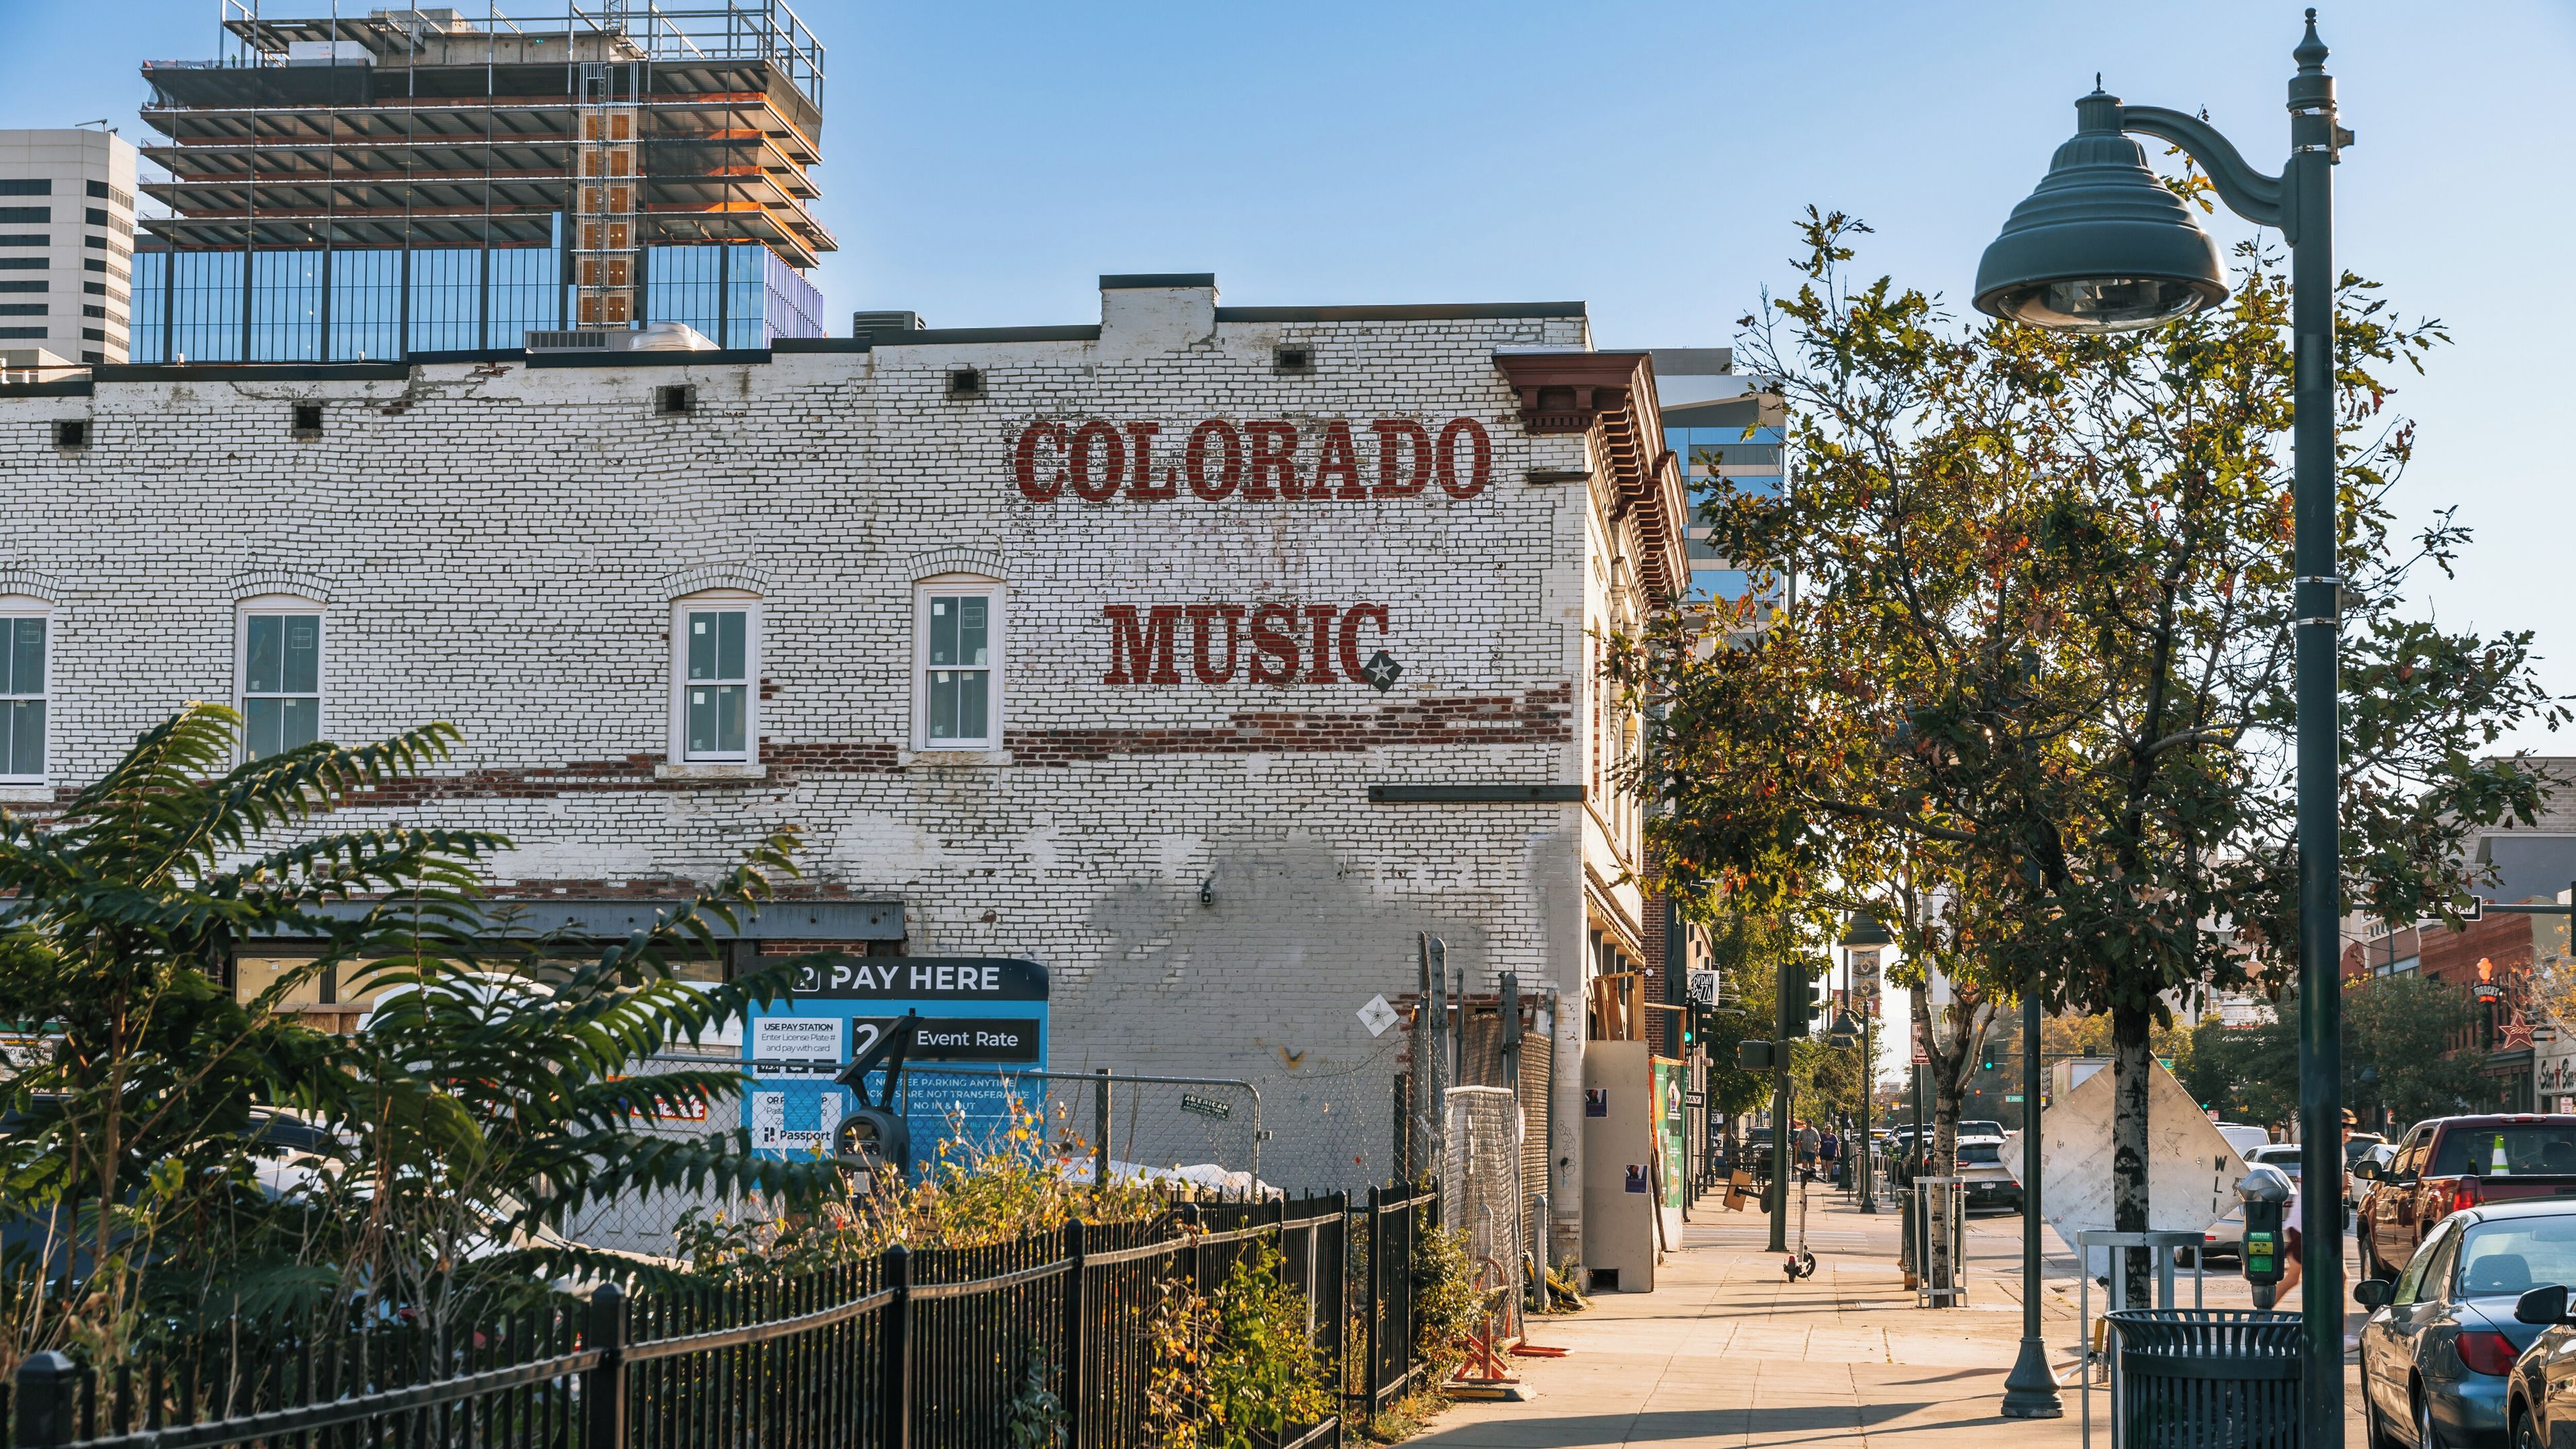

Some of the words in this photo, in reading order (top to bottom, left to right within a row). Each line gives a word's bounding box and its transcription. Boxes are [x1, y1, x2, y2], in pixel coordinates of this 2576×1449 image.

[1014, 417, 1492, 502] COLORADO
[1103, 604, 1389, 686] MUSIC
[831, 966, 899, 989] PAY
[910, 967, 1000, 989] HERE
[1692, 985, 1712, 1002] PIZZA
[918, 1030, 969, 1046] Event
[976, 1032, 1018, 1046] Rate
[922, 1079, 967, 1087] PARKING
[970, 1079, 1014, 1087] ANYTIME
[951, 1091, 1029, 1099] TRANSFERABLE
[1185, 1095, 1228, 1110] AMERICAN
[780, 1130, 830, 1142] Passport
